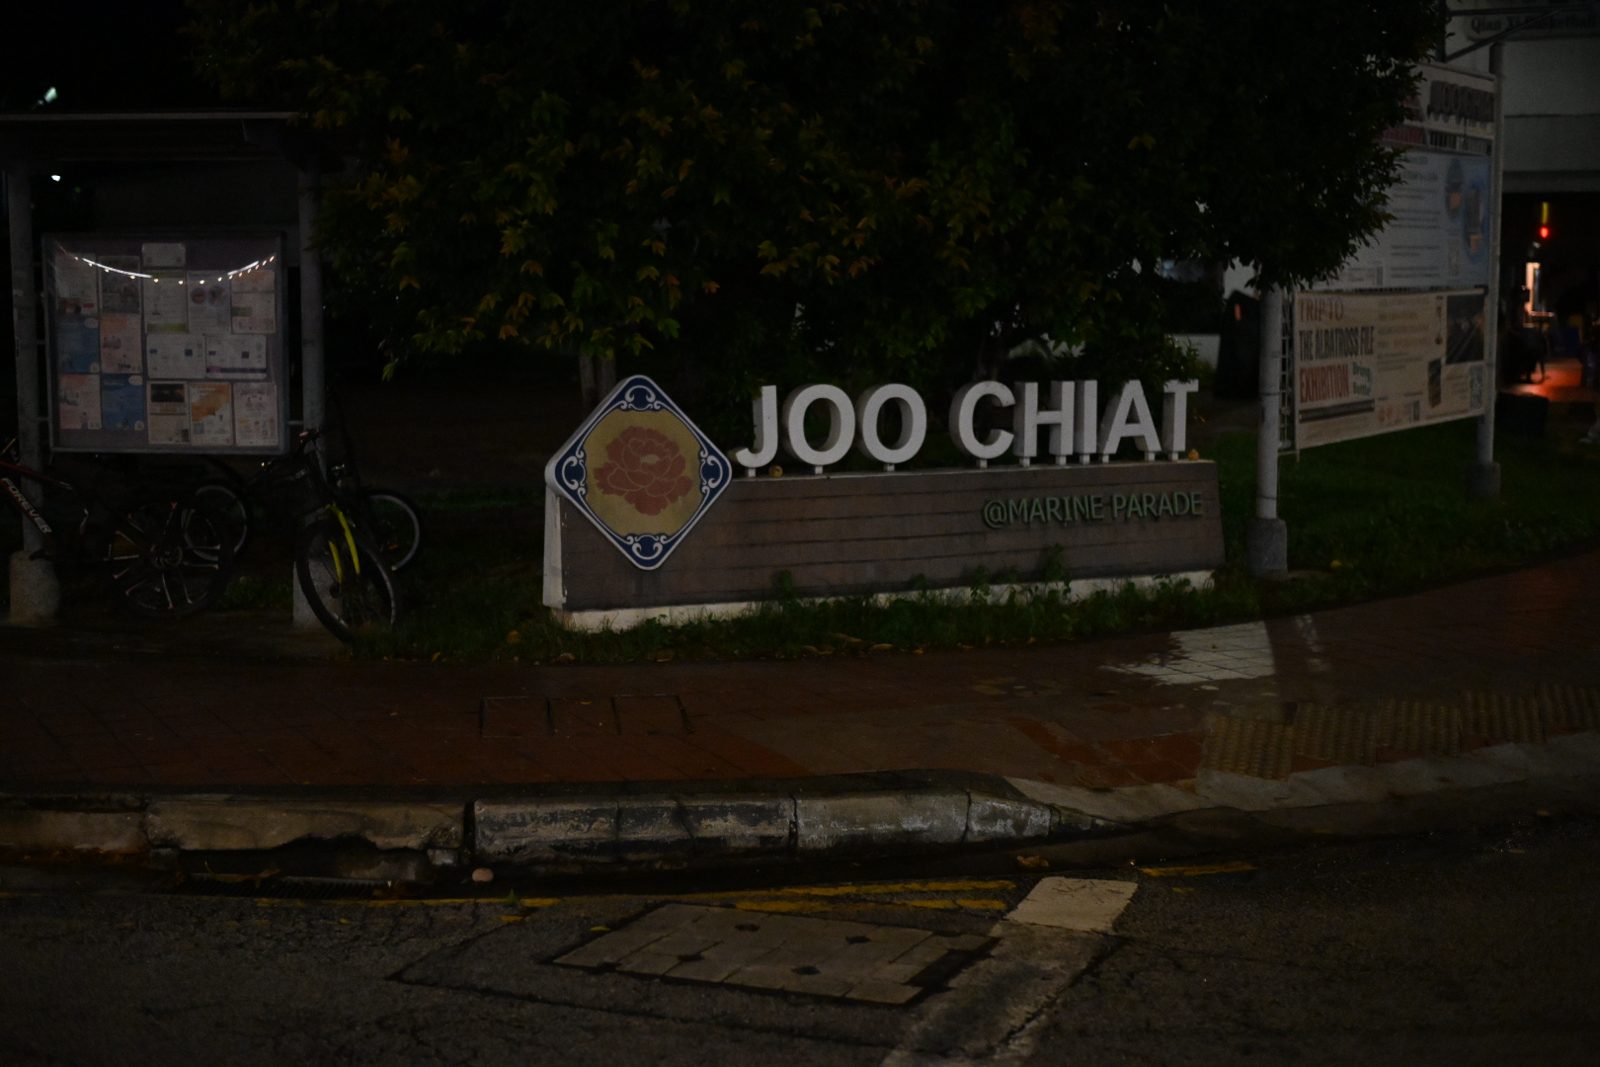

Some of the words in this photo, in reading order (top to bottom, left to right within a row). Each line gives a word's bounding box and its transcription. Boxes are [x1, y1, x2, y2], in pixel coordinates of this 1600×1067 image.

[1299, 329, 1313, 361] THE
[1300, 363, 1350, 404] EXHIBITION
[730, 383, 928, 468] JOO
[950, 379, 1200, 459] CHIAT
[983, 494, 1105, 529] @MARINE
[1110, 490, 1204, 520] PARADE
